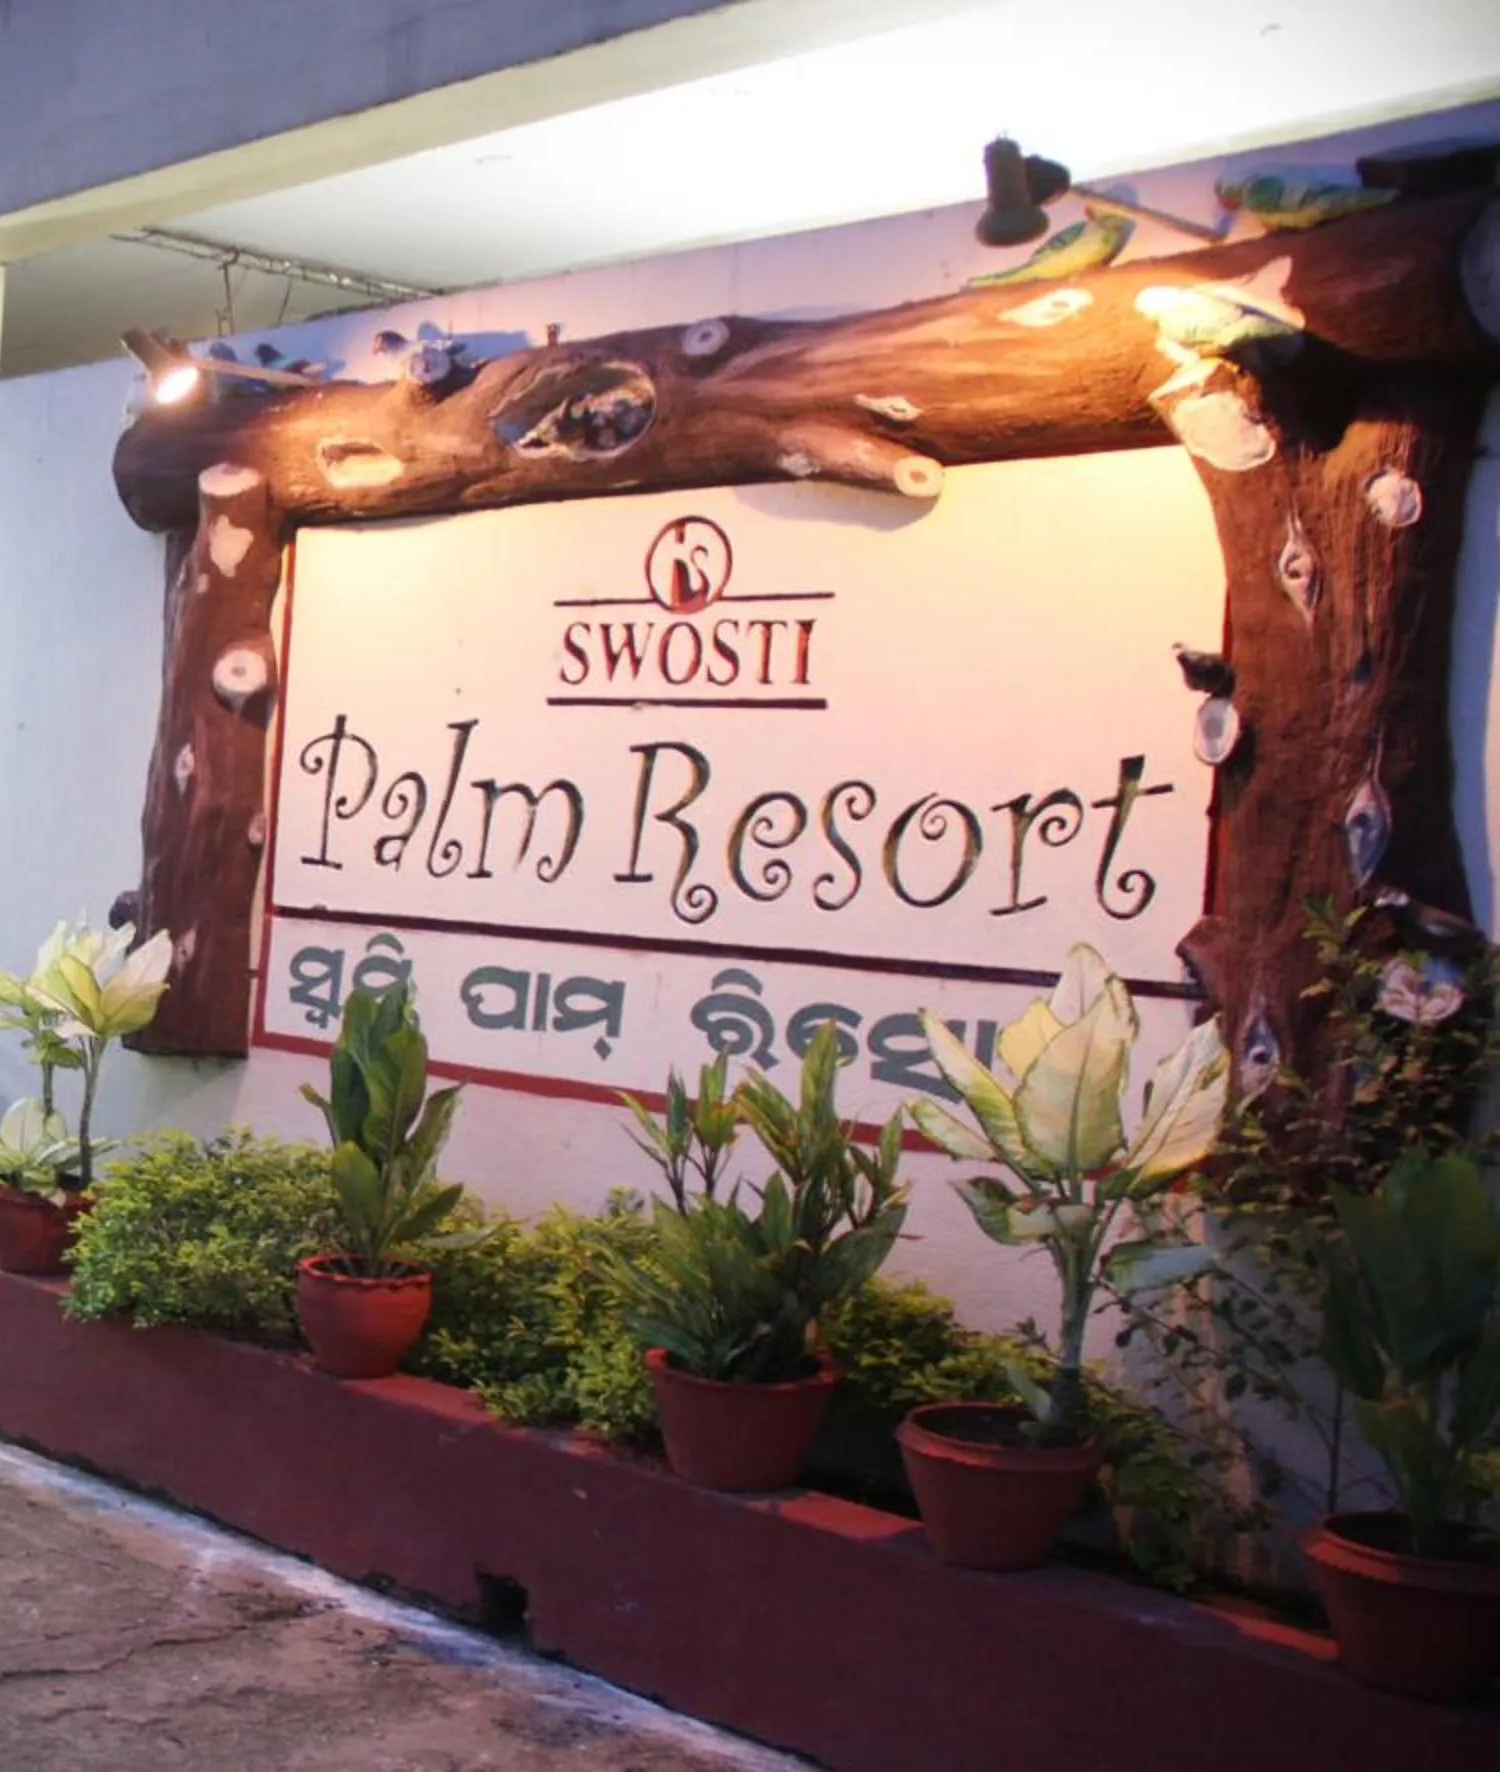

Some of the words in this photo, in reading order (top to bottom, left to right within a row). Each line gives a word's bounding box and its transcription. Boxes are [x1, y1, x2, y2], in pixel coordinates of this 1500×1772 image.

[560, 619, 816, 686] SWOSTI
[299, 714, 584, 884] Palm
[613, 740, 1174, 924] Resort
[460, 965, 626, 1061] ପାମ୍
